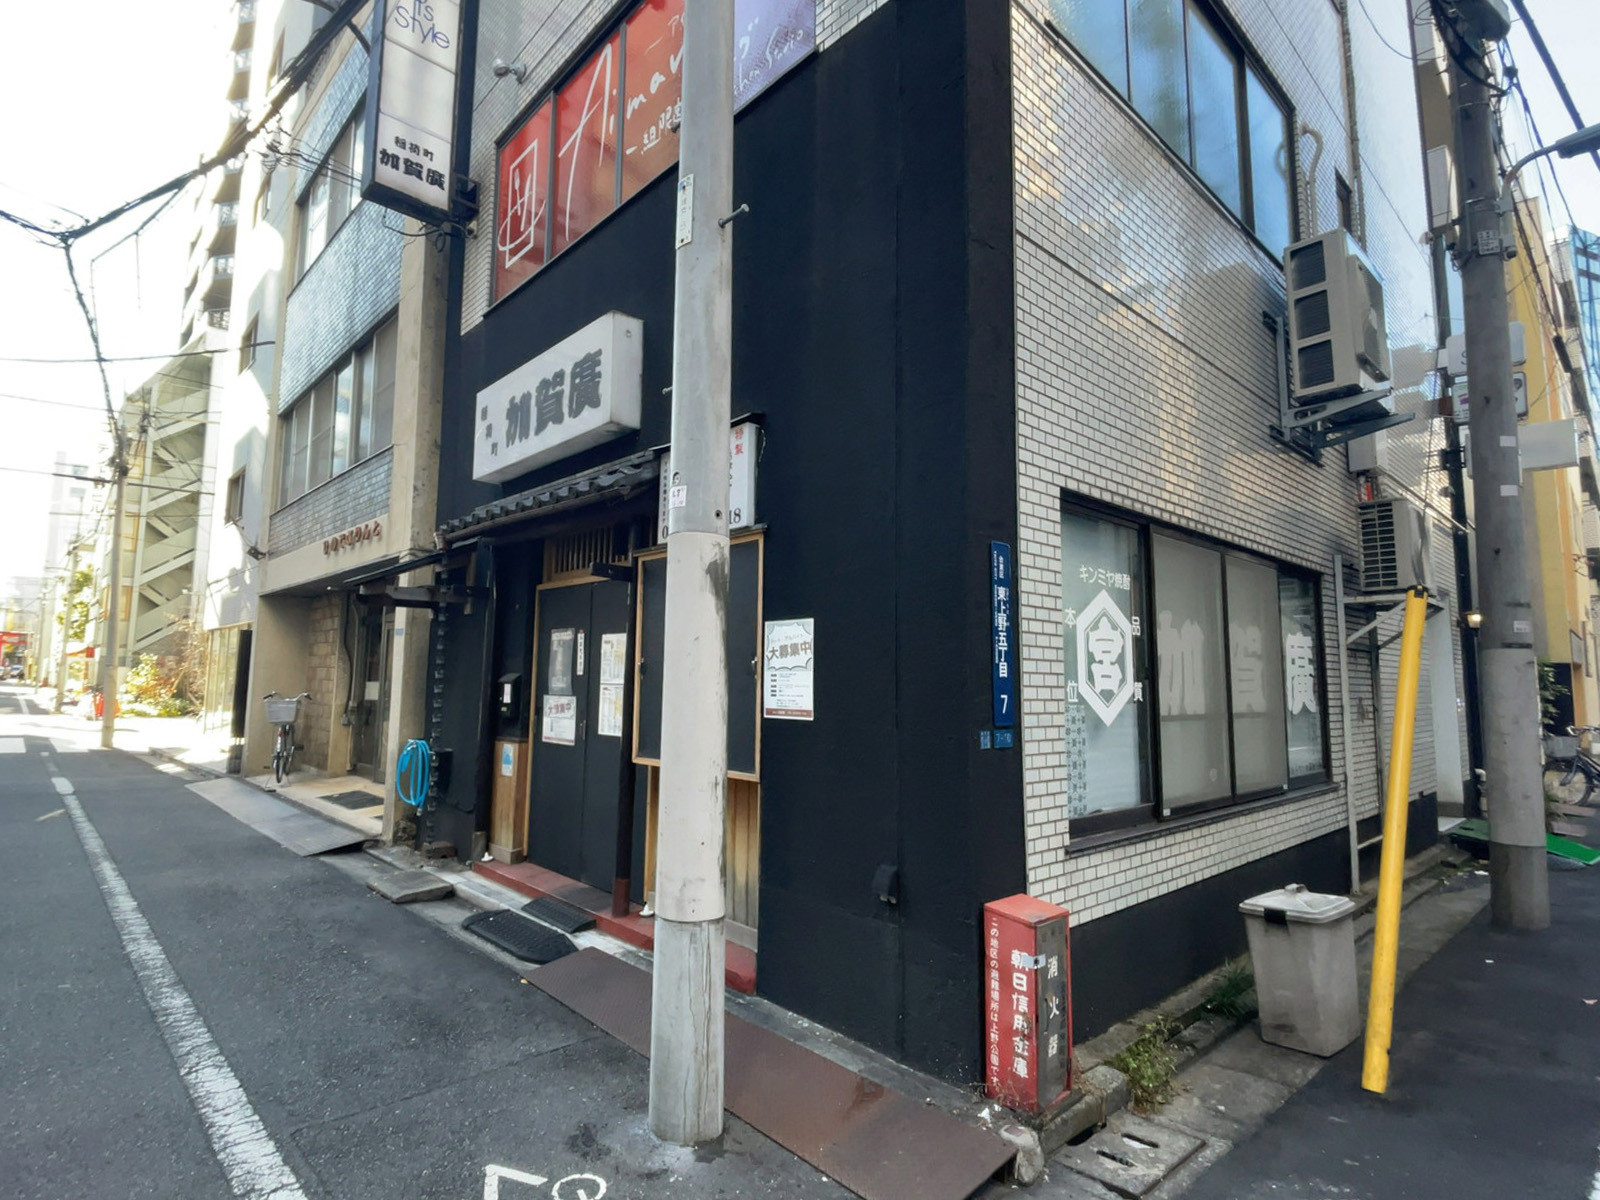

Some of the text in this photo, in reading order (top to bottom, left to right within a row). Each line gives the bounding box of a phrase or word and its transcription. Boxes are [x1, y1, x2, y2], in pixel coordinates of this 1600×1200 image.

[394, 5, 450, 49] Style
[505, 348, 603, 448] 加賀廣
[1079, 564, 1131, 591] キンミヤ焼酎
[768, 639, 811, 661] 大募集中
[1000, 694, 1008, 714] 7
[1046, 954, 1060, 1059] 消火器
